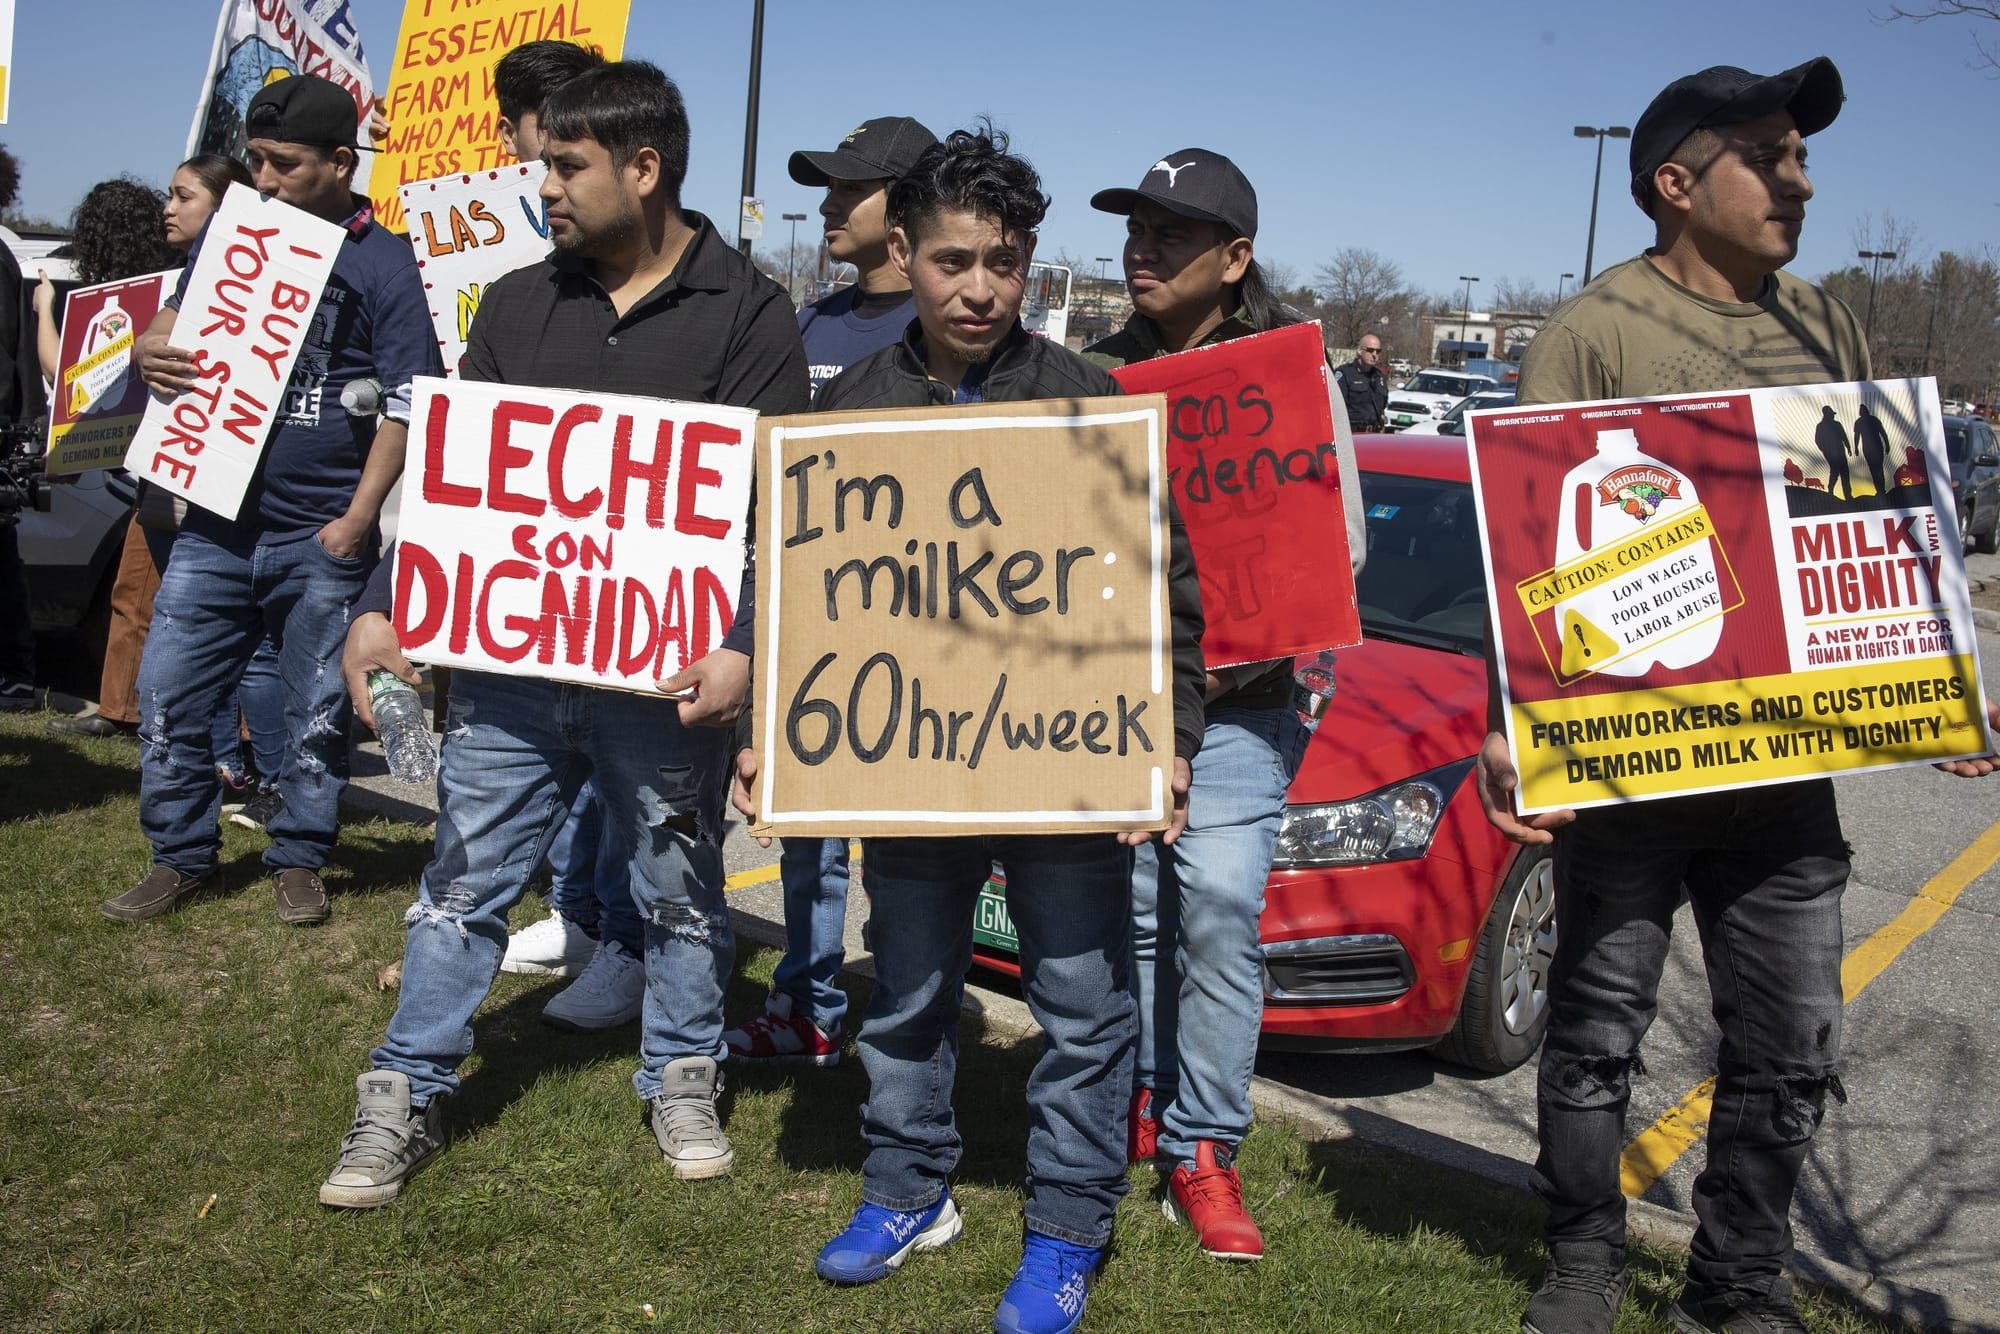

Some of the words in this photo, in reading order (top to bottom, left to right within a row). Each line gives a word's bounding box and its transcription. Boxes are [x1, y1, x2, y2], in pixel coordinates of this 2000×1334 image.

[403, 0, 592, 70] ESSENTIAL
[390, 71, 470, 122] FARM
[386, 117, 442, 155] WHO
[400, 150, 461, 186] LESS
[289, 245, 323, 260] I
[421, 200, 505, 257] LAS
[199, 225, 280, 338] YOUR
[250, 280, 311, 382] BUY
[55, 426, 125, 447] FARMWORKERS
[150, 349, 231, 490] STORE
[222, 388, 268, 446] IN
[1170, 384, 1274, 442] cas
[1493, 414, 1565, 427] MIGRANTJUSTICE.NET
[1581, 408, 1642, 419] @MIGRANTJUSTICE
[1660, 401, 1730, 414] MILKWITHDIGNITY.ORG
[62, 447, 100, 464] DEMAND
[422, 393, 742, 540] LECHE
[1604, 470, 1673, 494] Hannaford
[785, 449, 904, 549] I'm
[948, 467, 1003, 529] a
[511, 524, 613, 571] CON
[1791, 515, 1924, 564] MILK
[1925, 513, 1941, 552] WITH
[824, 539, 1118, 622] milker:
[1528, 559, 1615, 607] CAUTION:
[1617, 516, 1706, 566] CONTAINS
[1612, 578, 1644, 602] LOW
[1648, 554, 1698, 586] WAGES
[1797, 555, 1942, 617] DIGNITY
[392, 540, 736, 688] DIGNIDAD
[1611, 601, 1651, 625] POOR
[1652, 570, 1716, 608] HOUSING
[1623, 614, 1673, 645] LABOR
[1676, 592, 1720, 622] ABUSE
[1807, 632, 1821, 647] A
[1826, 627, 1869, 644] NEW
[1875, 622, 1911, 638] DAY
[1916, 618, 1953, 634] FOR
[1807, 646, 1851, 665] HUMAN
[1856, 640, 1899, 661] RIGHTS
[1903, 638, 1916, 655] IN
[1920, 634, 1955, 653] DAIRY
[1531, 701, 1742, 749] FARMWORKERS
[1750, 693, 1804, 723] AND
[1813, 675, 1966, 715] CUSTOMERS
[1566, 743, 1682, 784] DEMAND
[1692, 736, 1759, 770] MILK
[1767, 729, 1835, 761] WITH
[1843, 715, 1942, 751] DIGNITY
